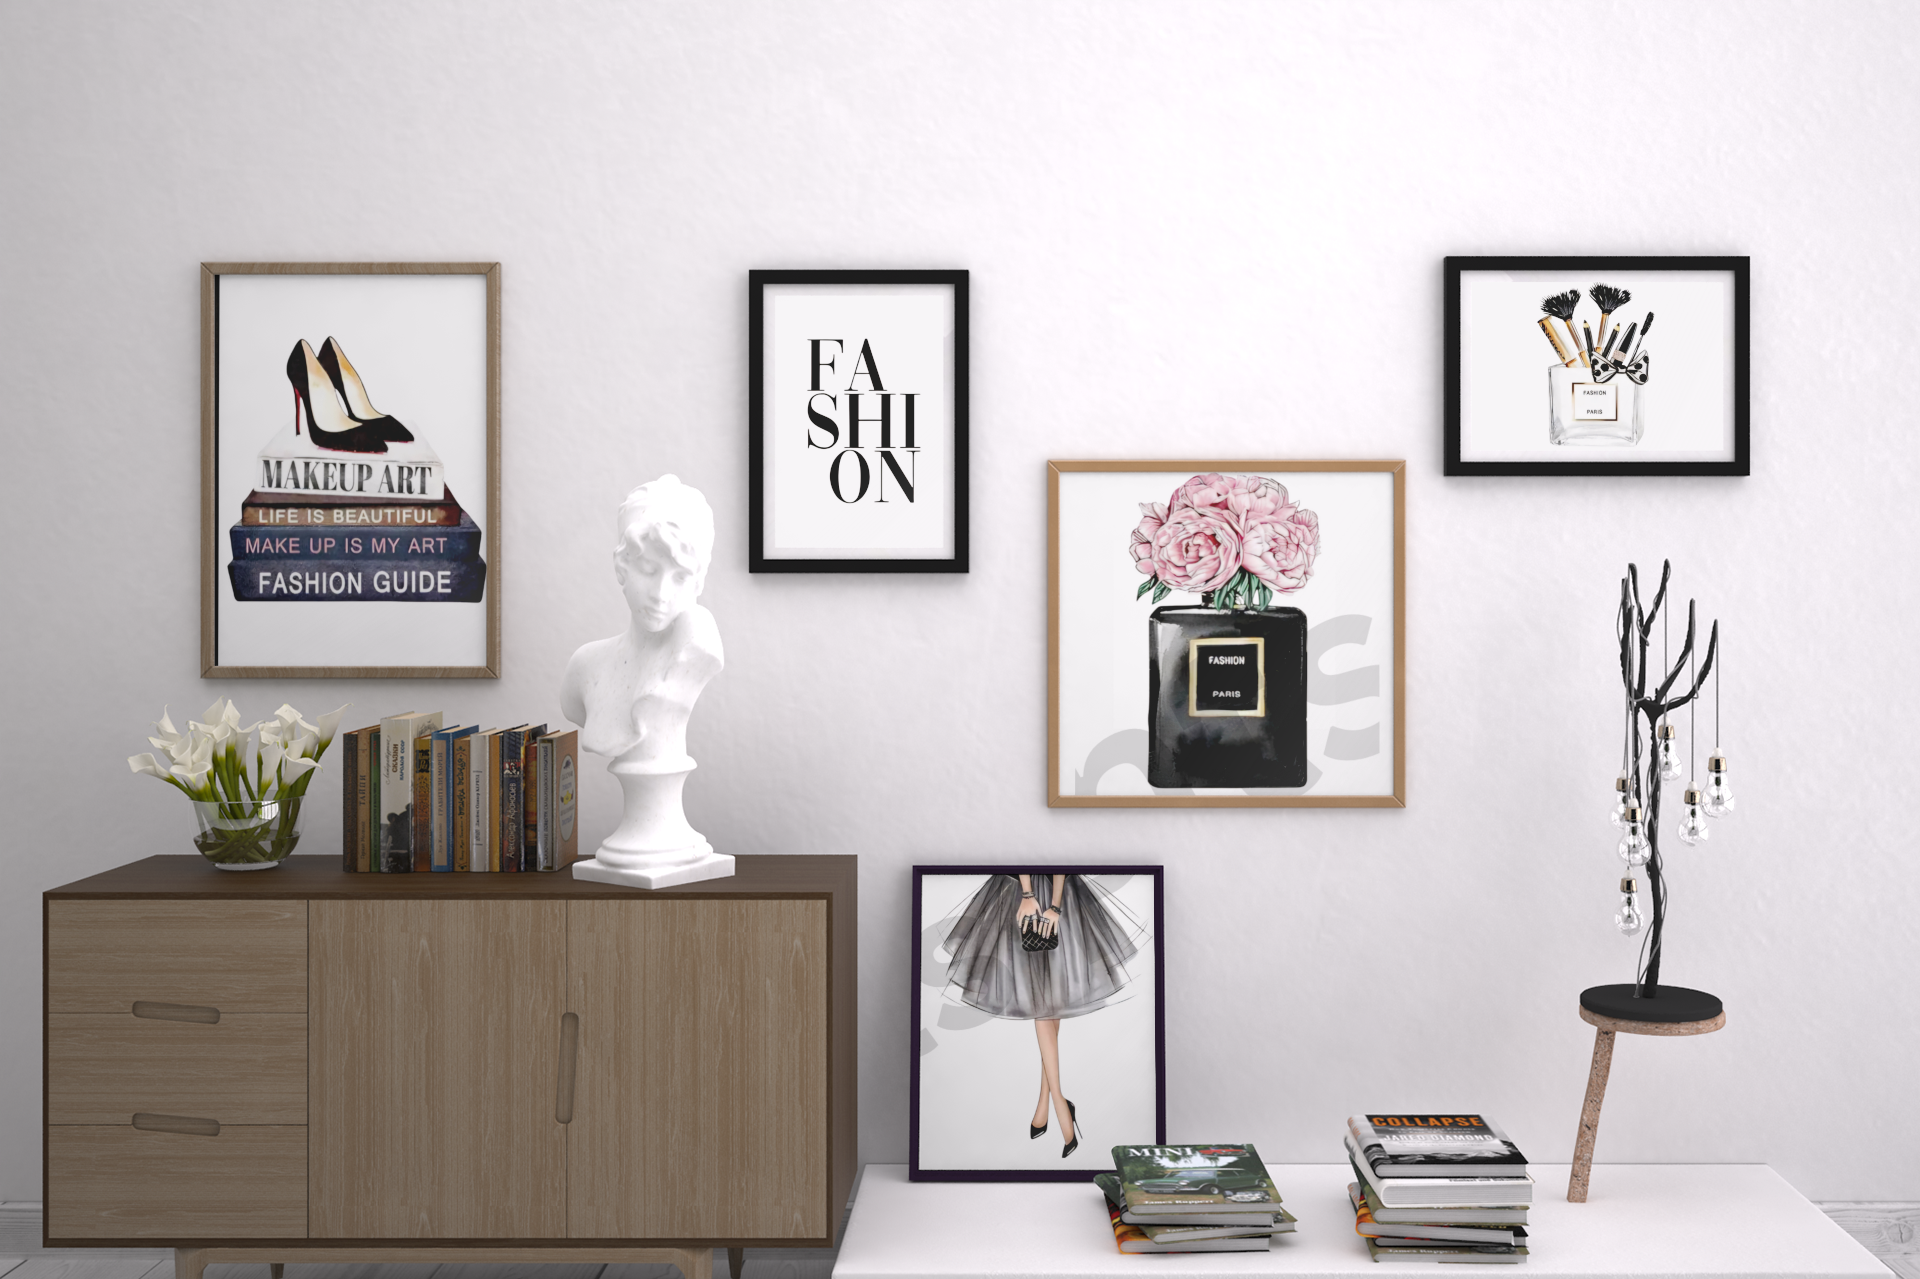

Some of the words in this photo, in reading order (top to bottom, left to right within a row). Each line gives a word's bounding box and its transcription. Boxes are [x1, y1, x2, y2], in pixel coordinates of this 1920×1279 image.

[807, 338, 888, 391] FA
[807, 393, 921, 449] SHI
[261, 459, 373, 492] MAKEUP
[378, 465, 432, 495] ART
[829, 449, 921, 504] ON
[258, 509, 298, 523] LIFE
[307, 509, 324, 523] IS
[334, 509, 437, 523] BEAUTIFUL
[245, 537, 300, 554] MAKE
[310, 537, 335, 554] UP
[345, 537, 362, 554] IS
[371, 537, 400, 554] MY
[408, 537, 447, 554] ART
[259, 572, 362, 594] FASHION
[373, 570, 452, 593] GUIDE
[1208, 656, 1245, 665] FASHION
[1212, 690, 1241, 698] PARIS
[358, 775, 366, 806] ТАЙПИ
[1371, 1117, 1484, 1127] COLLAPSE
[1128, 1147, 1194, 1157] MINI
